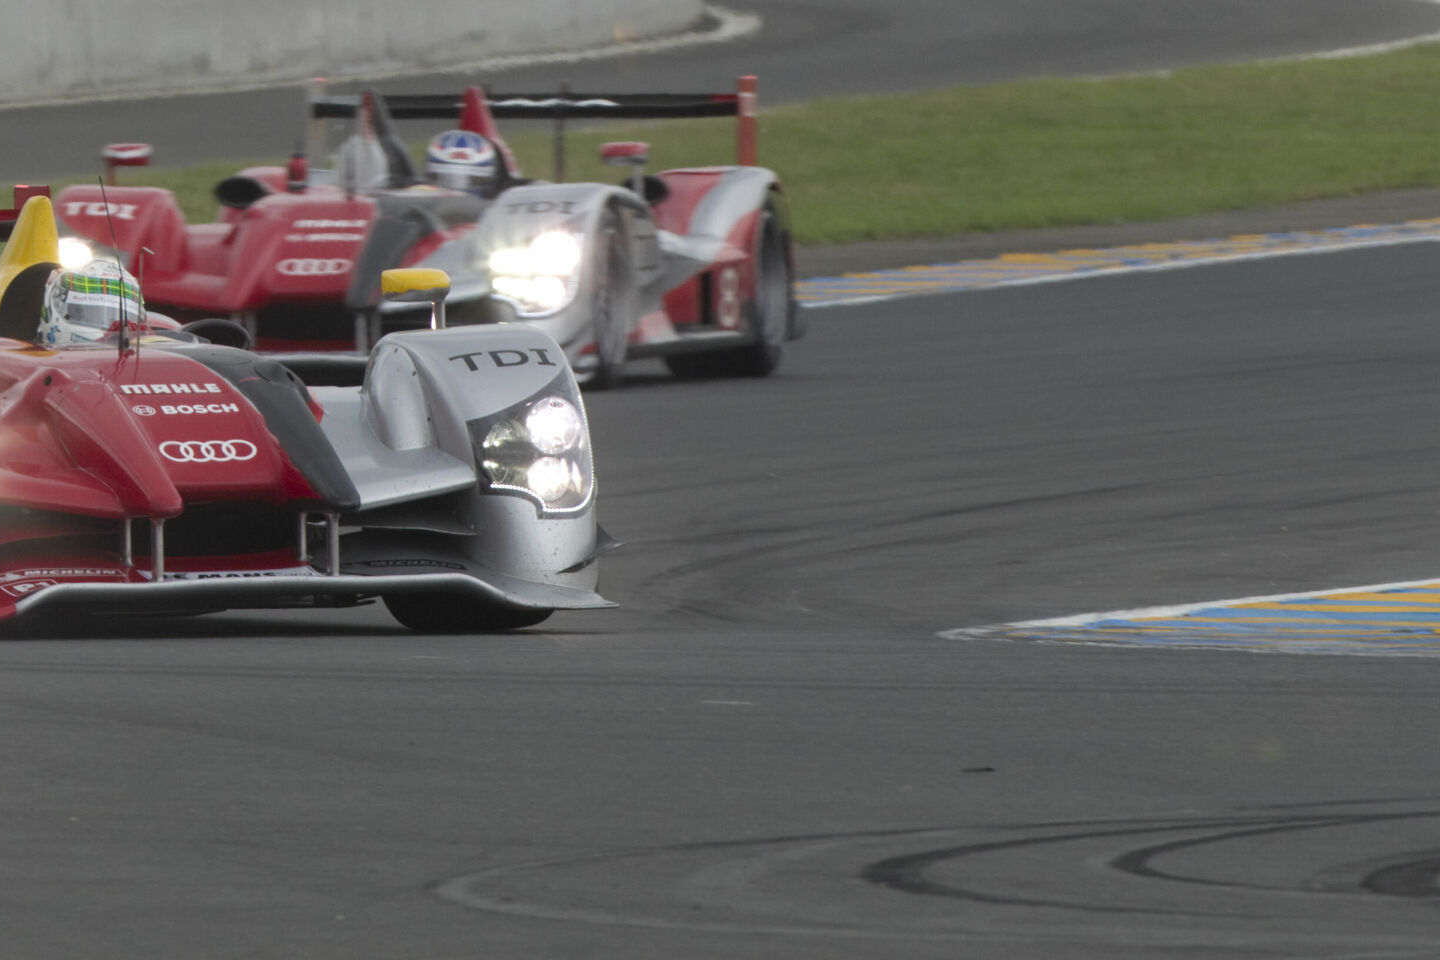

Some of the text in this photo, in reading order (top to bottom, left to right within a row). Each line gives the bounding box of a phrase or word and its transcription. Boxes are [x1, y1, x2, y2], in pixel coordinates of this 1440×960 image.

[63, 201, 139, 220] TDI
[503, 200, 575, 216] TDI
[448, 348, 557, 372] TDI
[120, 383, 222, 394] MAHLE
[160, 403, 239, 415] BOSCH
[23, 569, 117, 577] MICHELIN
